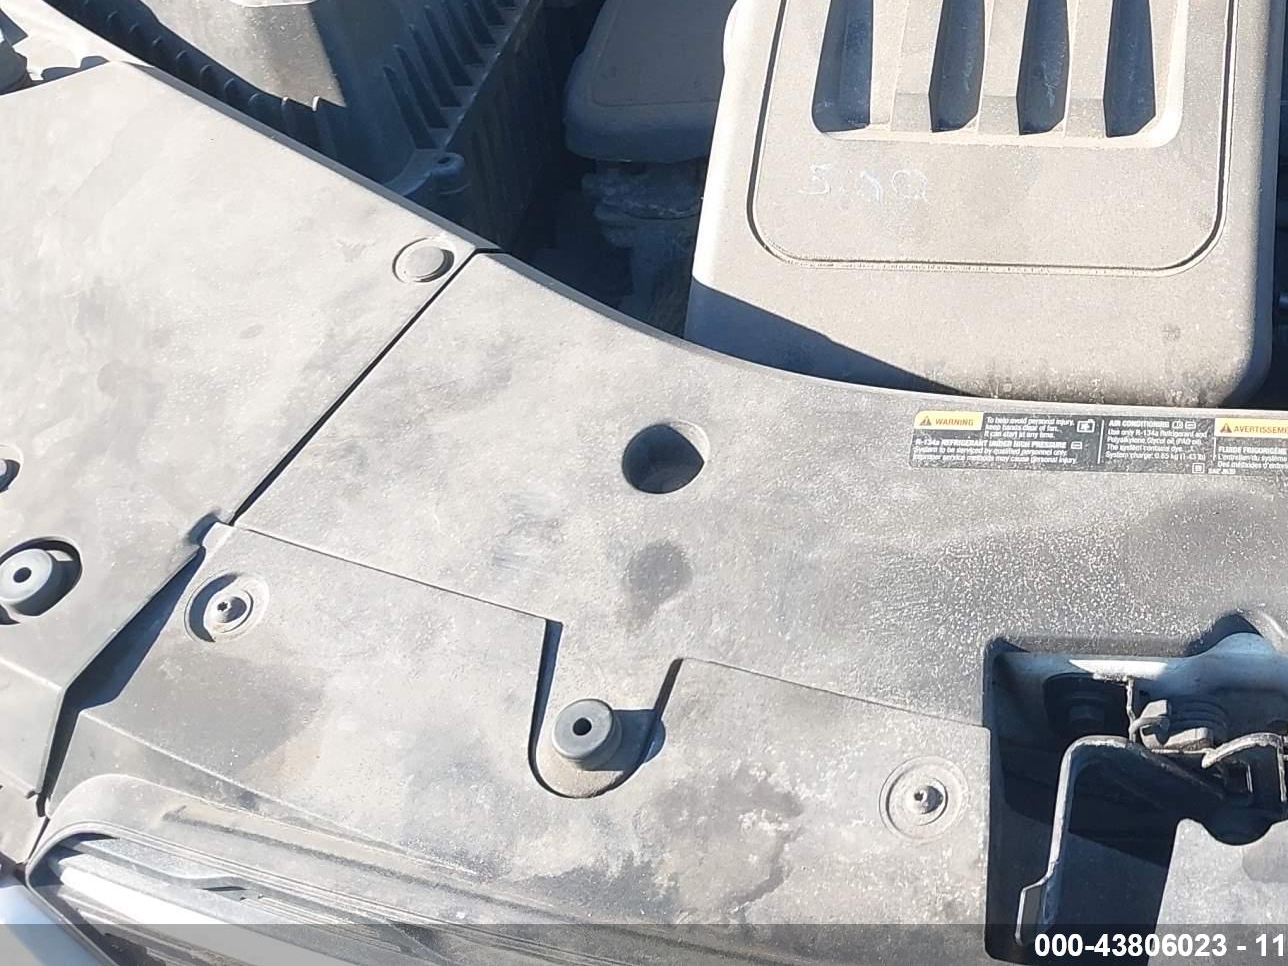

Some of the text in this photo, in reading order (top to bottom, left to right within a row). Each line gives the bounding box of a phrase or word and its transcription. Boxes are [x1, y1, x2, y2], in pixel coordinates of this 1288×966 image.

[936, 417, 974, 426] WARNING
[1028, 418, 1055, 426] personal
[1109, 419, 1121, 427] AIR
[1121, 429, 1134, 437] only
[1135, 429, 1159, 437] R-134a
[1195, 430, 1207, 438] and
[915, 437, 1067, 449] R-134a REFRIGERANT UNDER HIGH PRESSURE
[1146, 437, 1166, 445] Glycol
[913, 445, 938, 454] System
[947, 446, 955, 454] be
[956, 446, 983, 454] serviced
[984, 447, 993, 455] by
[994, 447, 1020, 455] qualified
[1107, 443, 1118, 451] The
[995, 455, 1010, 464] may
[1031, 455, 1058, 464] personal
[1105, 450, 1128, 459] System
[1170, 453, 1178, 461] kg
